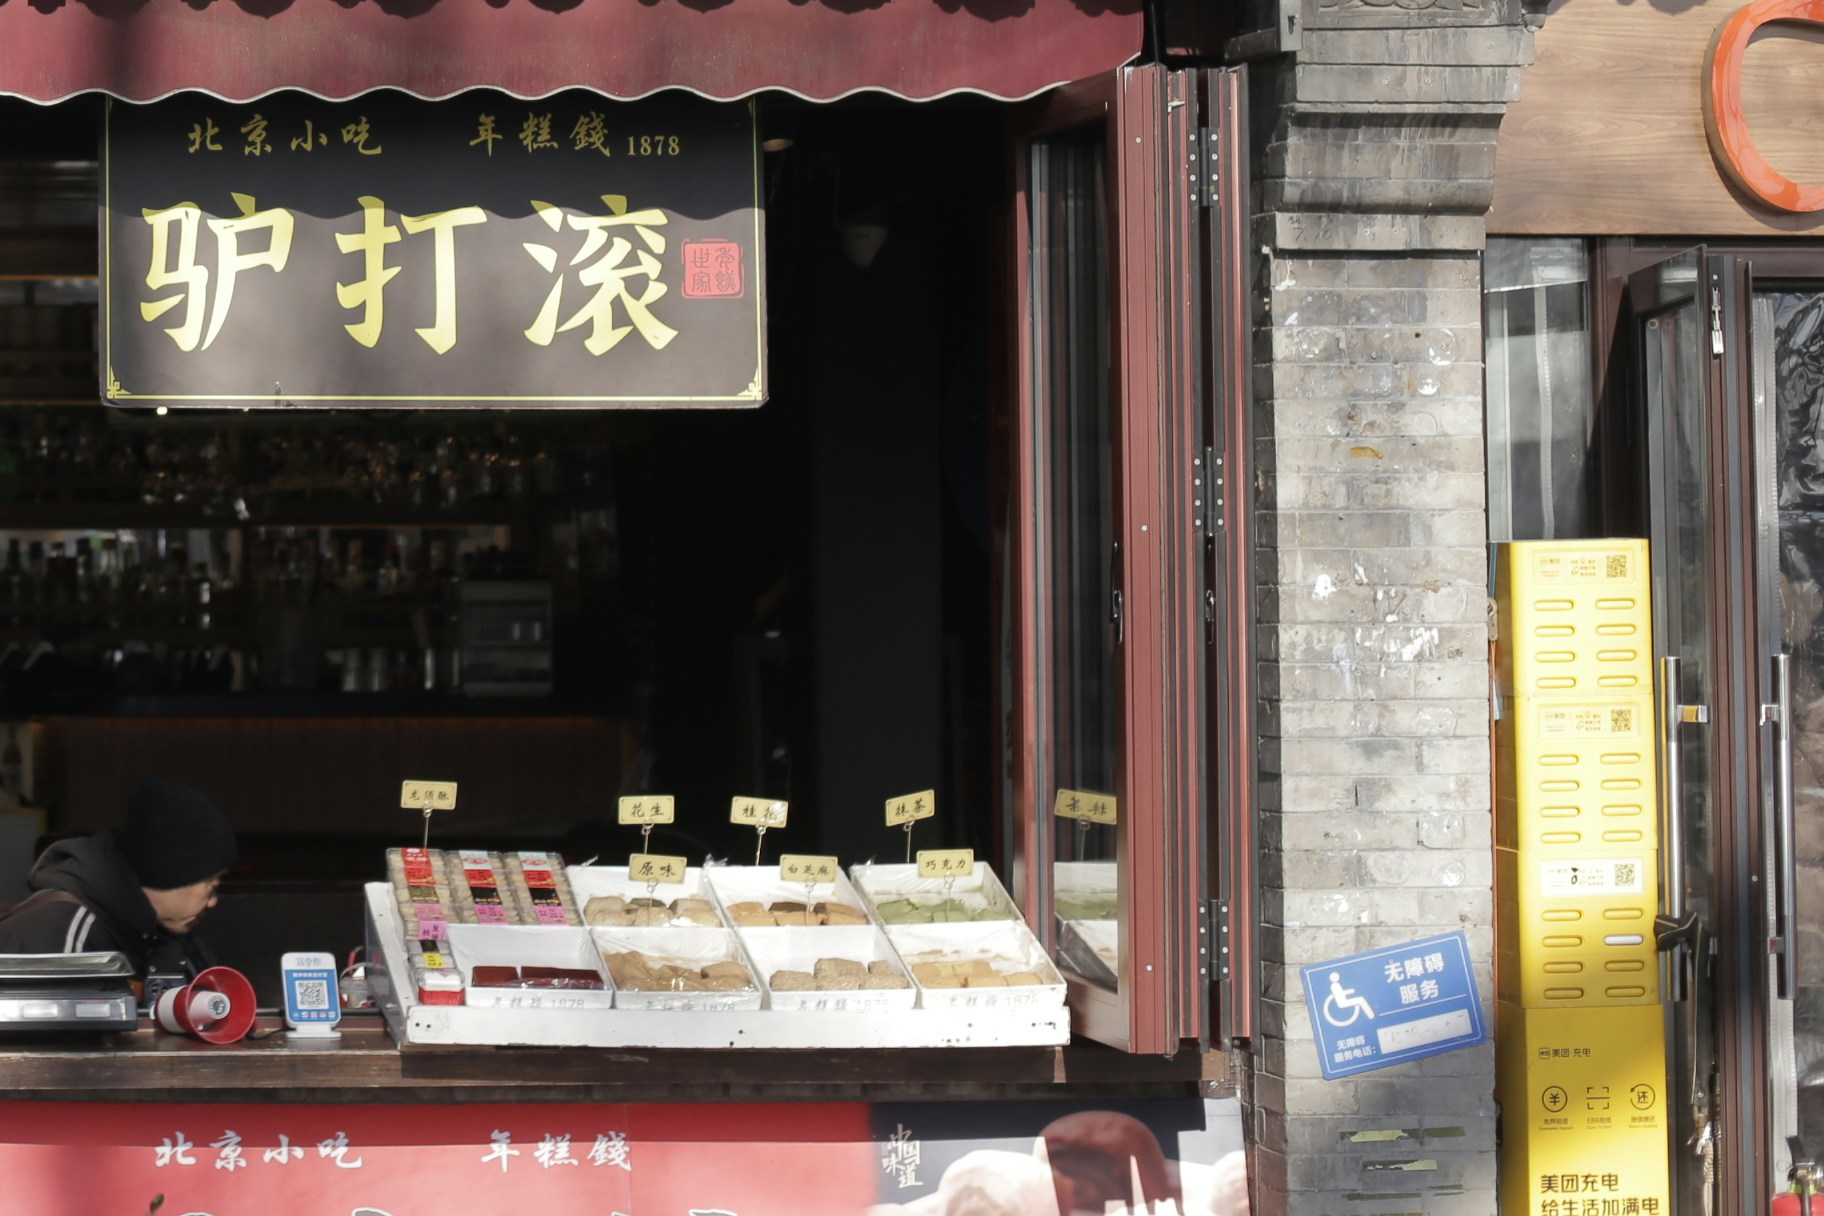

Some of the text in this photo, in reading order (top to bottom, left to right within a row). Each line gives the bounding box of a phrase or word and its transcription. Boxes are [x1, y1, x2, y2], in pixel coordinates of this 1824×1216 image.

[187, 110, 680, 157] 北京小吃 年糕錢 1878
[139, 192, 679, 357] 驴打滚
[631, 802, 665, 818] 花生
[894, 797, 927, 816] 抹茶
[638, 861, 676, 878] 原味
[787, 865, 830, 876] 白芝麻
[925, 857, 966, 871] 巧克力
[1384, 952, 1445, 984] 无障碍
[1399, 979, 1440, 1005] 服务
[1336, 1035, 1366, 1051] 无障碍
[154, 1129, 633, 1172] 北京小吃 年糕錢
[1540, 1173, 1619, 1194] 美团充电
[1541, 1196, 1660, 1216] 给生活加满电
